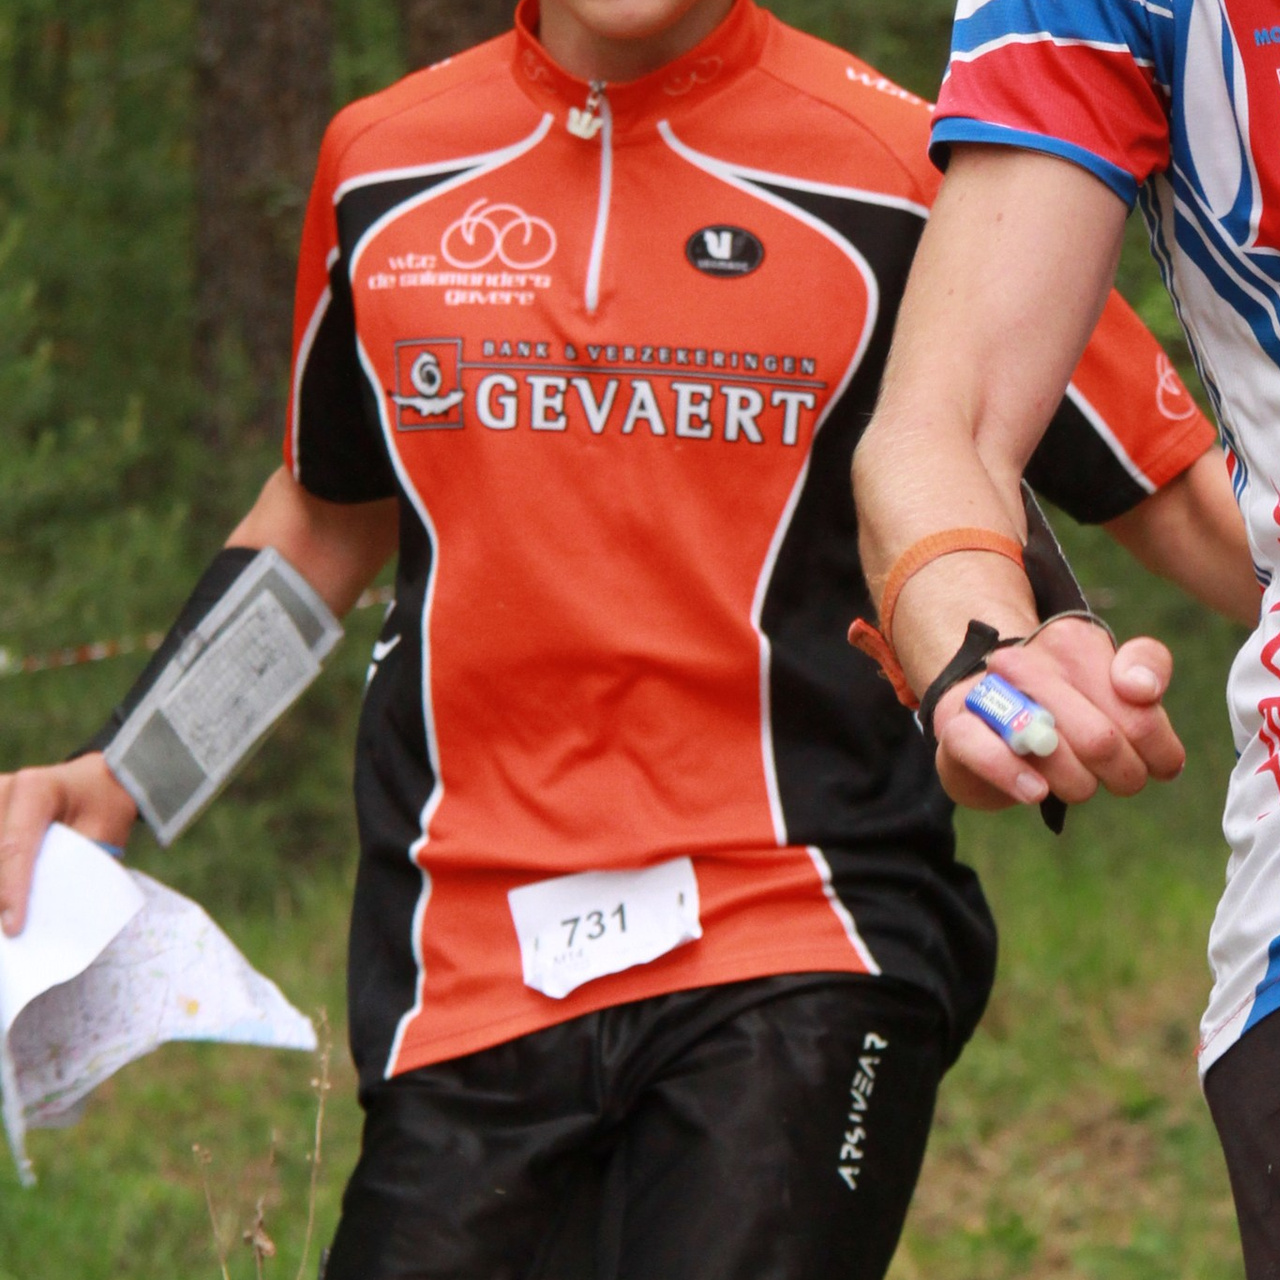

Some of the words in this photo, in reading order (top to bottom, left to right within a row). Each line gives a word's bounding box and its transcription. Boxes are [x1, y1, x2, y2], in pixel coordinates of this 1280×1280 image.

[483, 340, 548, 358] BANK
[587, 344, 816, 375] VERZEKERINGEN
[475, 372, 817, 446] GEVAERT
[560, 902, 627, 948] 731
